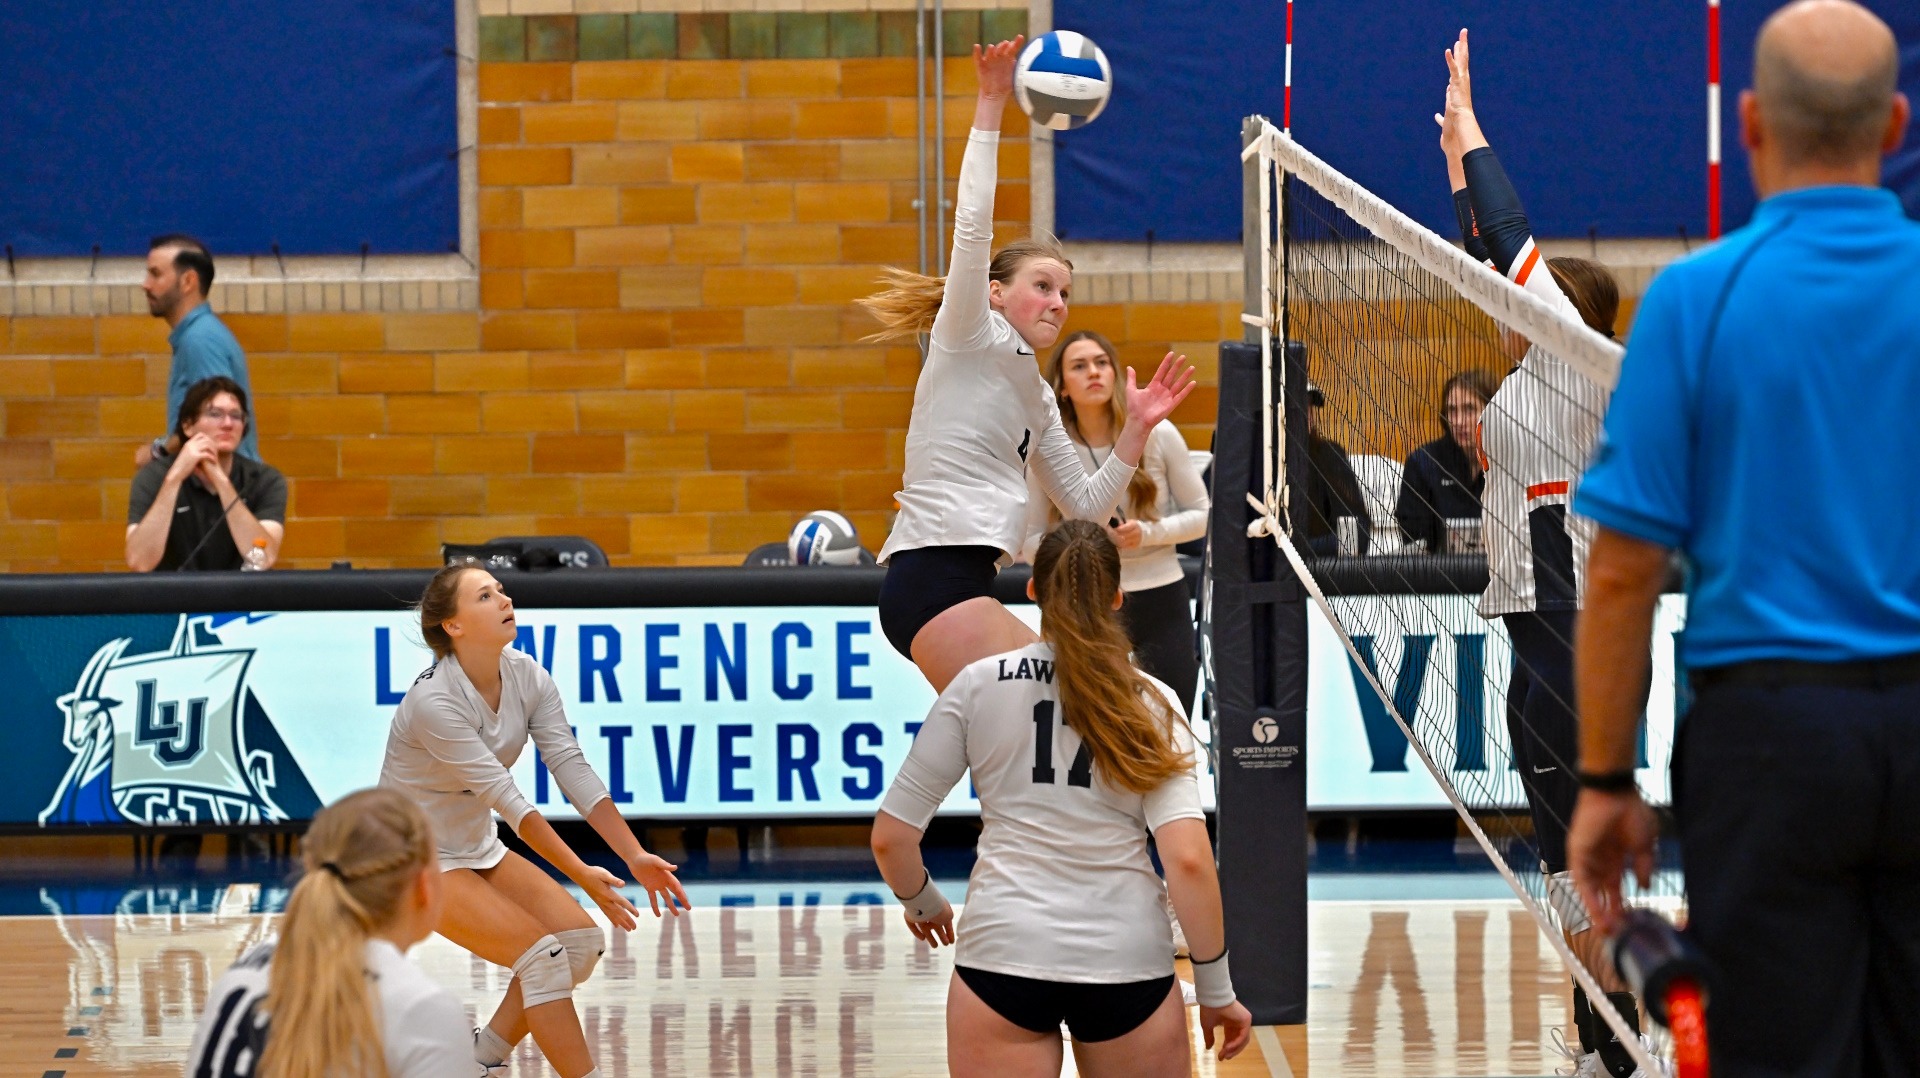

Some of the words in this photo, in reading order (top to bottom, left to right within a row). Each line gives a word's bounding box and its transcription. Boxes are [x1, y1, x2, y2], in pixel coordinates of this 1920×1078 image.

[375, 621, 873, 706] LRENCE
[998, 657, 1056, 685] LAW
[135, 679, 209, 768] LU
